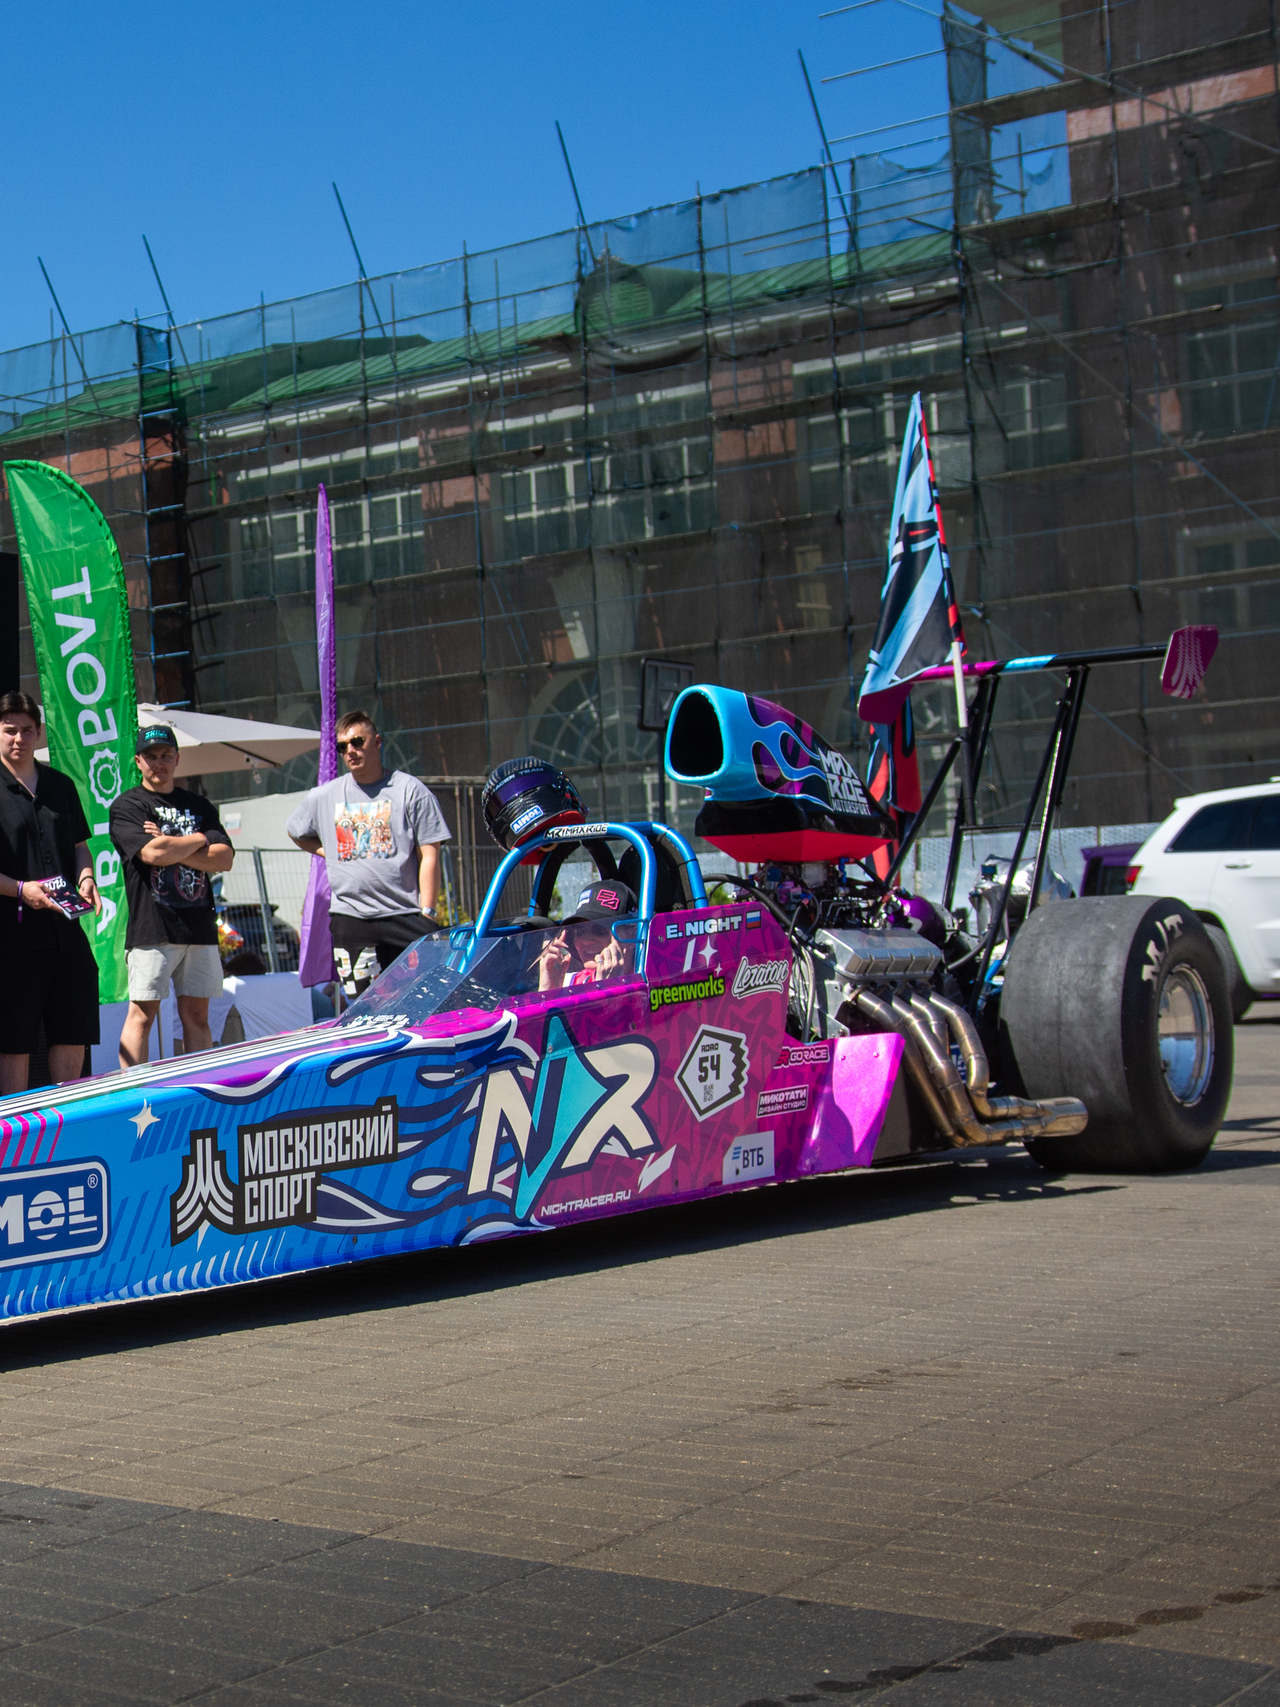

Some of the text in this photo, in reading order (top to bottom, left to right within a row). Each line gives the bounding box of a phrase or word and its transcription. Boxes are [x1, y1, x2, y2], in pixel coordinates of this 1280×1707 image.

[512, 807, 541, 832] AIMOL
[666, 915, 743, 939] E. NIGHT
[650, 974, 725, 1011] greenworks
[790, 1048, 828, 1062] GORACE
[698, 1054, 721, 1083] 54
[758, 1100, 806, 1116] ДИЗАЙН СТУДИО
[759, 1088, 807, 1105] МИКОТАТИ
[243, 1104, 395, 1178] МОСКОВСКИЙ
[742, 1147, 764, 1169] ВТБ
[244, 1172, 317, 1225] СПОРТ
[540, 1189, 631, 1217] NIGHTRACER.RU
